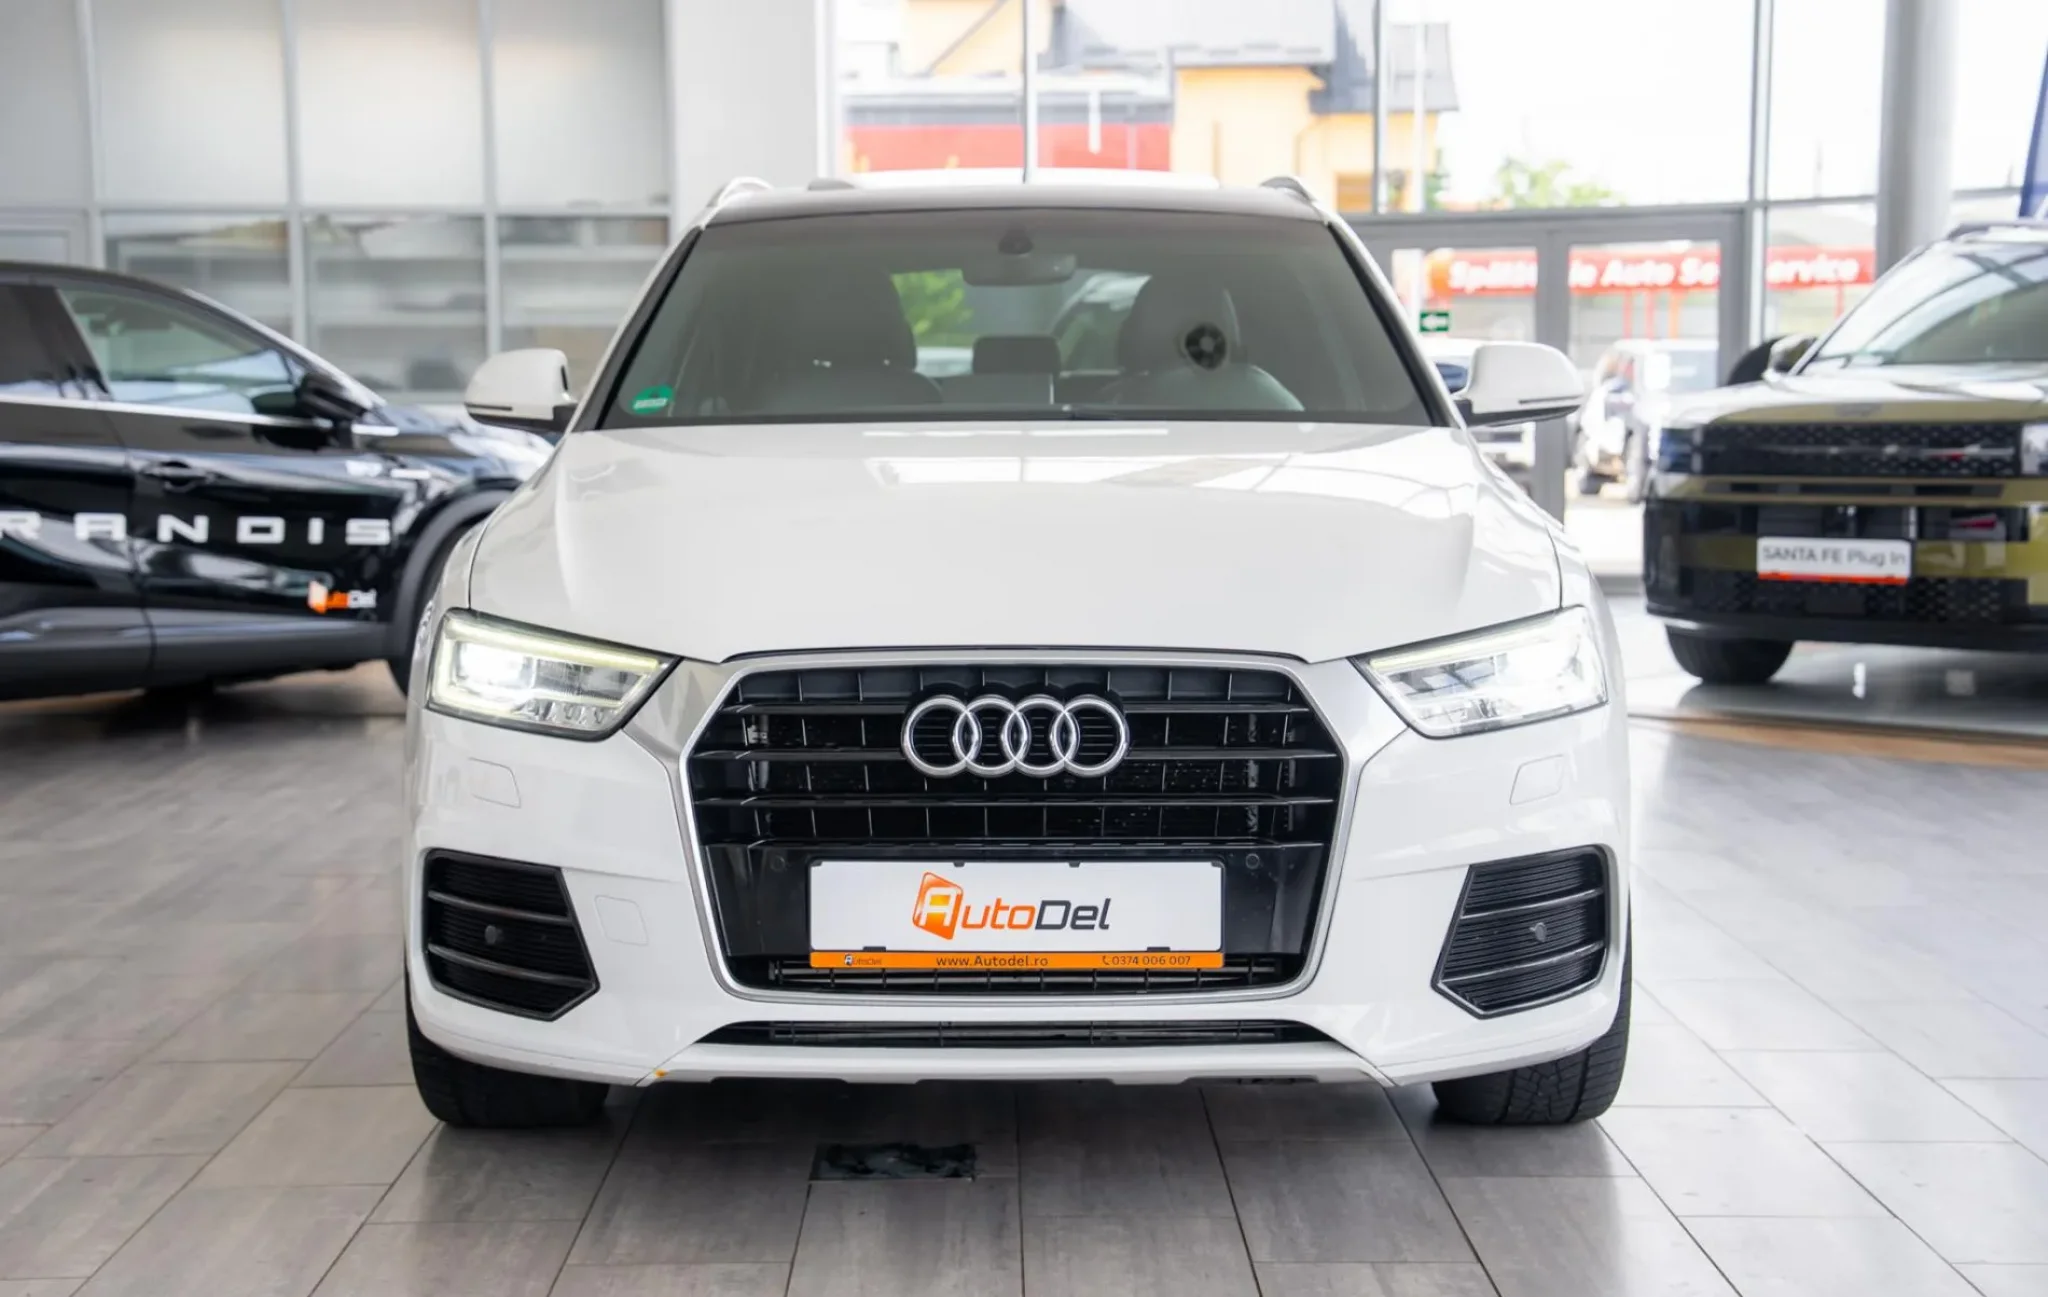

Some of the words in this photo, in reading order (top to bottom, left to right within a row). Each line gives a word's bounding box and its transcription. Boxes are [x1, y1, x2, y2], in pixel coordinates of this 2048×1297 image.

[1601, 257, 1676, 287] Auto
[1679, 257, 1720, 286] Se
[1766, 254, 1859, 283] ervice
[1763, 546, 1818, 561] SANTA
[1822, 548, 1842, 563] FE
[1847, 550, 1886, 567] Plug
[1890, 551, 1906, 564] In
[914, 878, 1111, 935] AutoDel
[935, 955, 1049, 967] www.Autodel.ro
[1111, 955, 1139, 966] 0374
[1142, 955, 1166, 966] 006
[1169, 955, 1191, 966] 007
